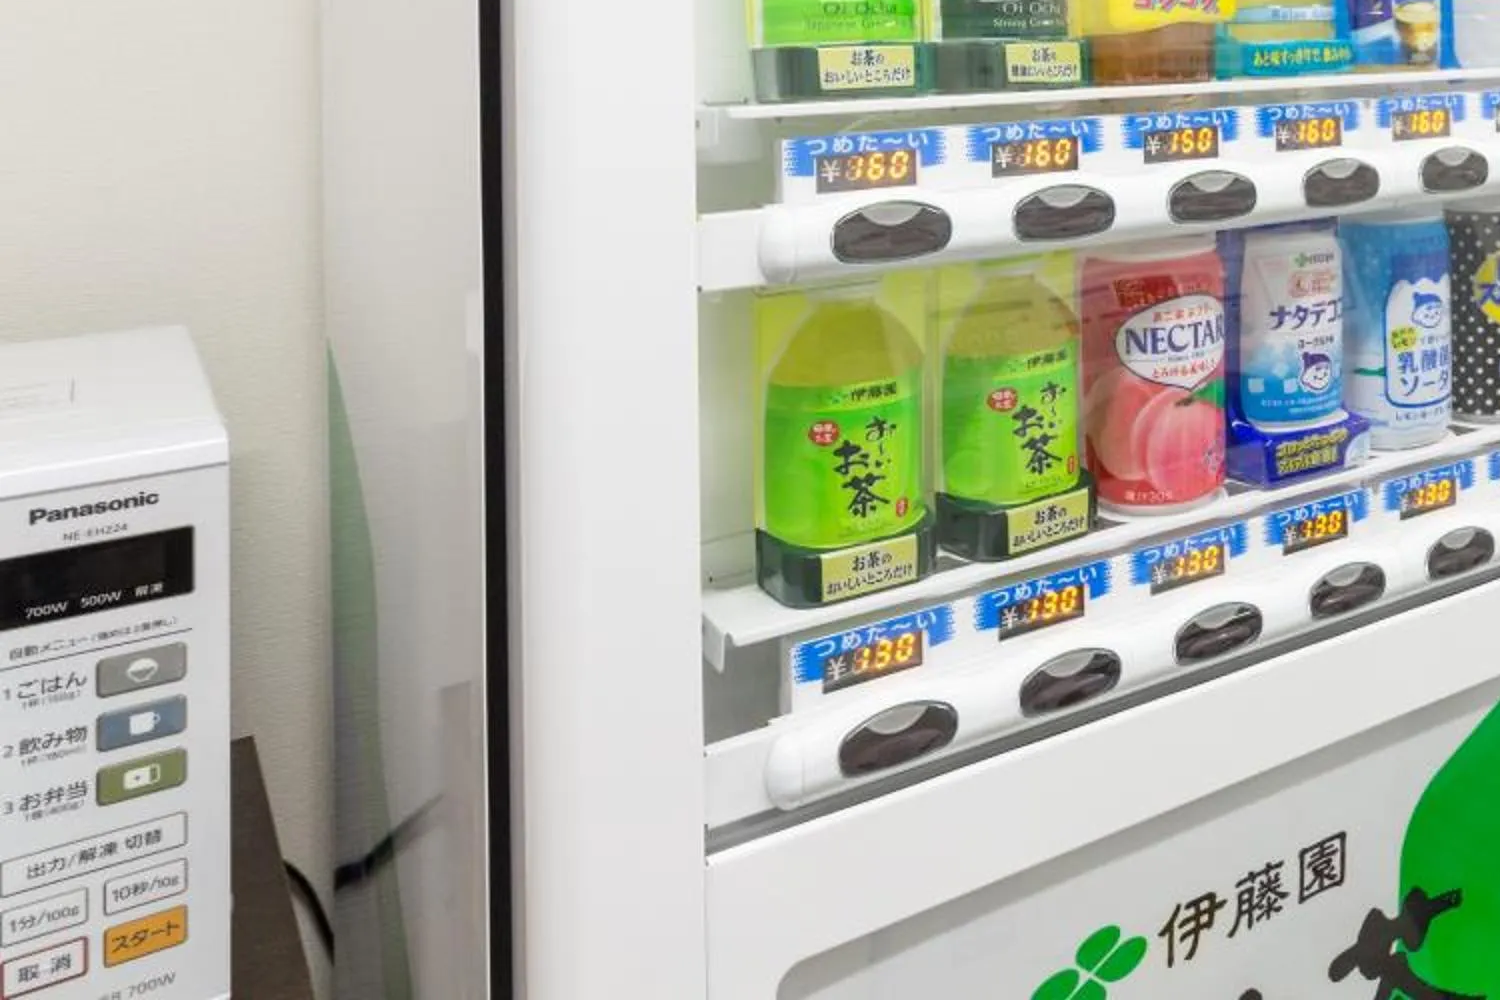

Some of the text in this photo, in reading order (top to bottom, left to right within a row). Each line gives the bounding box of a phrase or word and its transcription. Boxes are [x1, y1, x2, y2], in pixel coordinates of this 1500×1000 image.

[850, 49, 885, 67] お茶の
[823, 66, 912, 85] おいしいところだけ
[1276, 117, 1336, 143] ¥160
[819, 151, 910, 183] ¥160
[995, 138, 1072, 169] ¥160
[1124, 311, 1225, 356] NECTAR
[1012, 404, 1064, 475] お茶
[833, 439, 890, 518] お茶
[28, 491, 160, 526] Panasonic
[1033, 505, 1068, 527] お茶の
[1012, 515, 1086, 548] おいしいところだけ
[1284, 509, 1343, 543] ¥130
[851, 551, 893, 573] お茶の
[1151, 546, 1218, 586] ¥130
[826, 563, 914, 597] おいしいところだけ
[25, 601, 69, 620] 700W
[80, 590, 122, 609] 500W
[1002, 585, 1080, 630] ¥130
[826, 632, 918, 681] ¥130
[18, 672, 87, 700] ごはん
[19, 726, 88, 756] 飲み物
[19, 779, 88, 812] お弁当
[124, 828, 163, 851] 切替
[1157, 829, 1348, 969] 伊藤園
[111, 919, 181, 953] スタート
[127, 971, 177, 998] 700W
